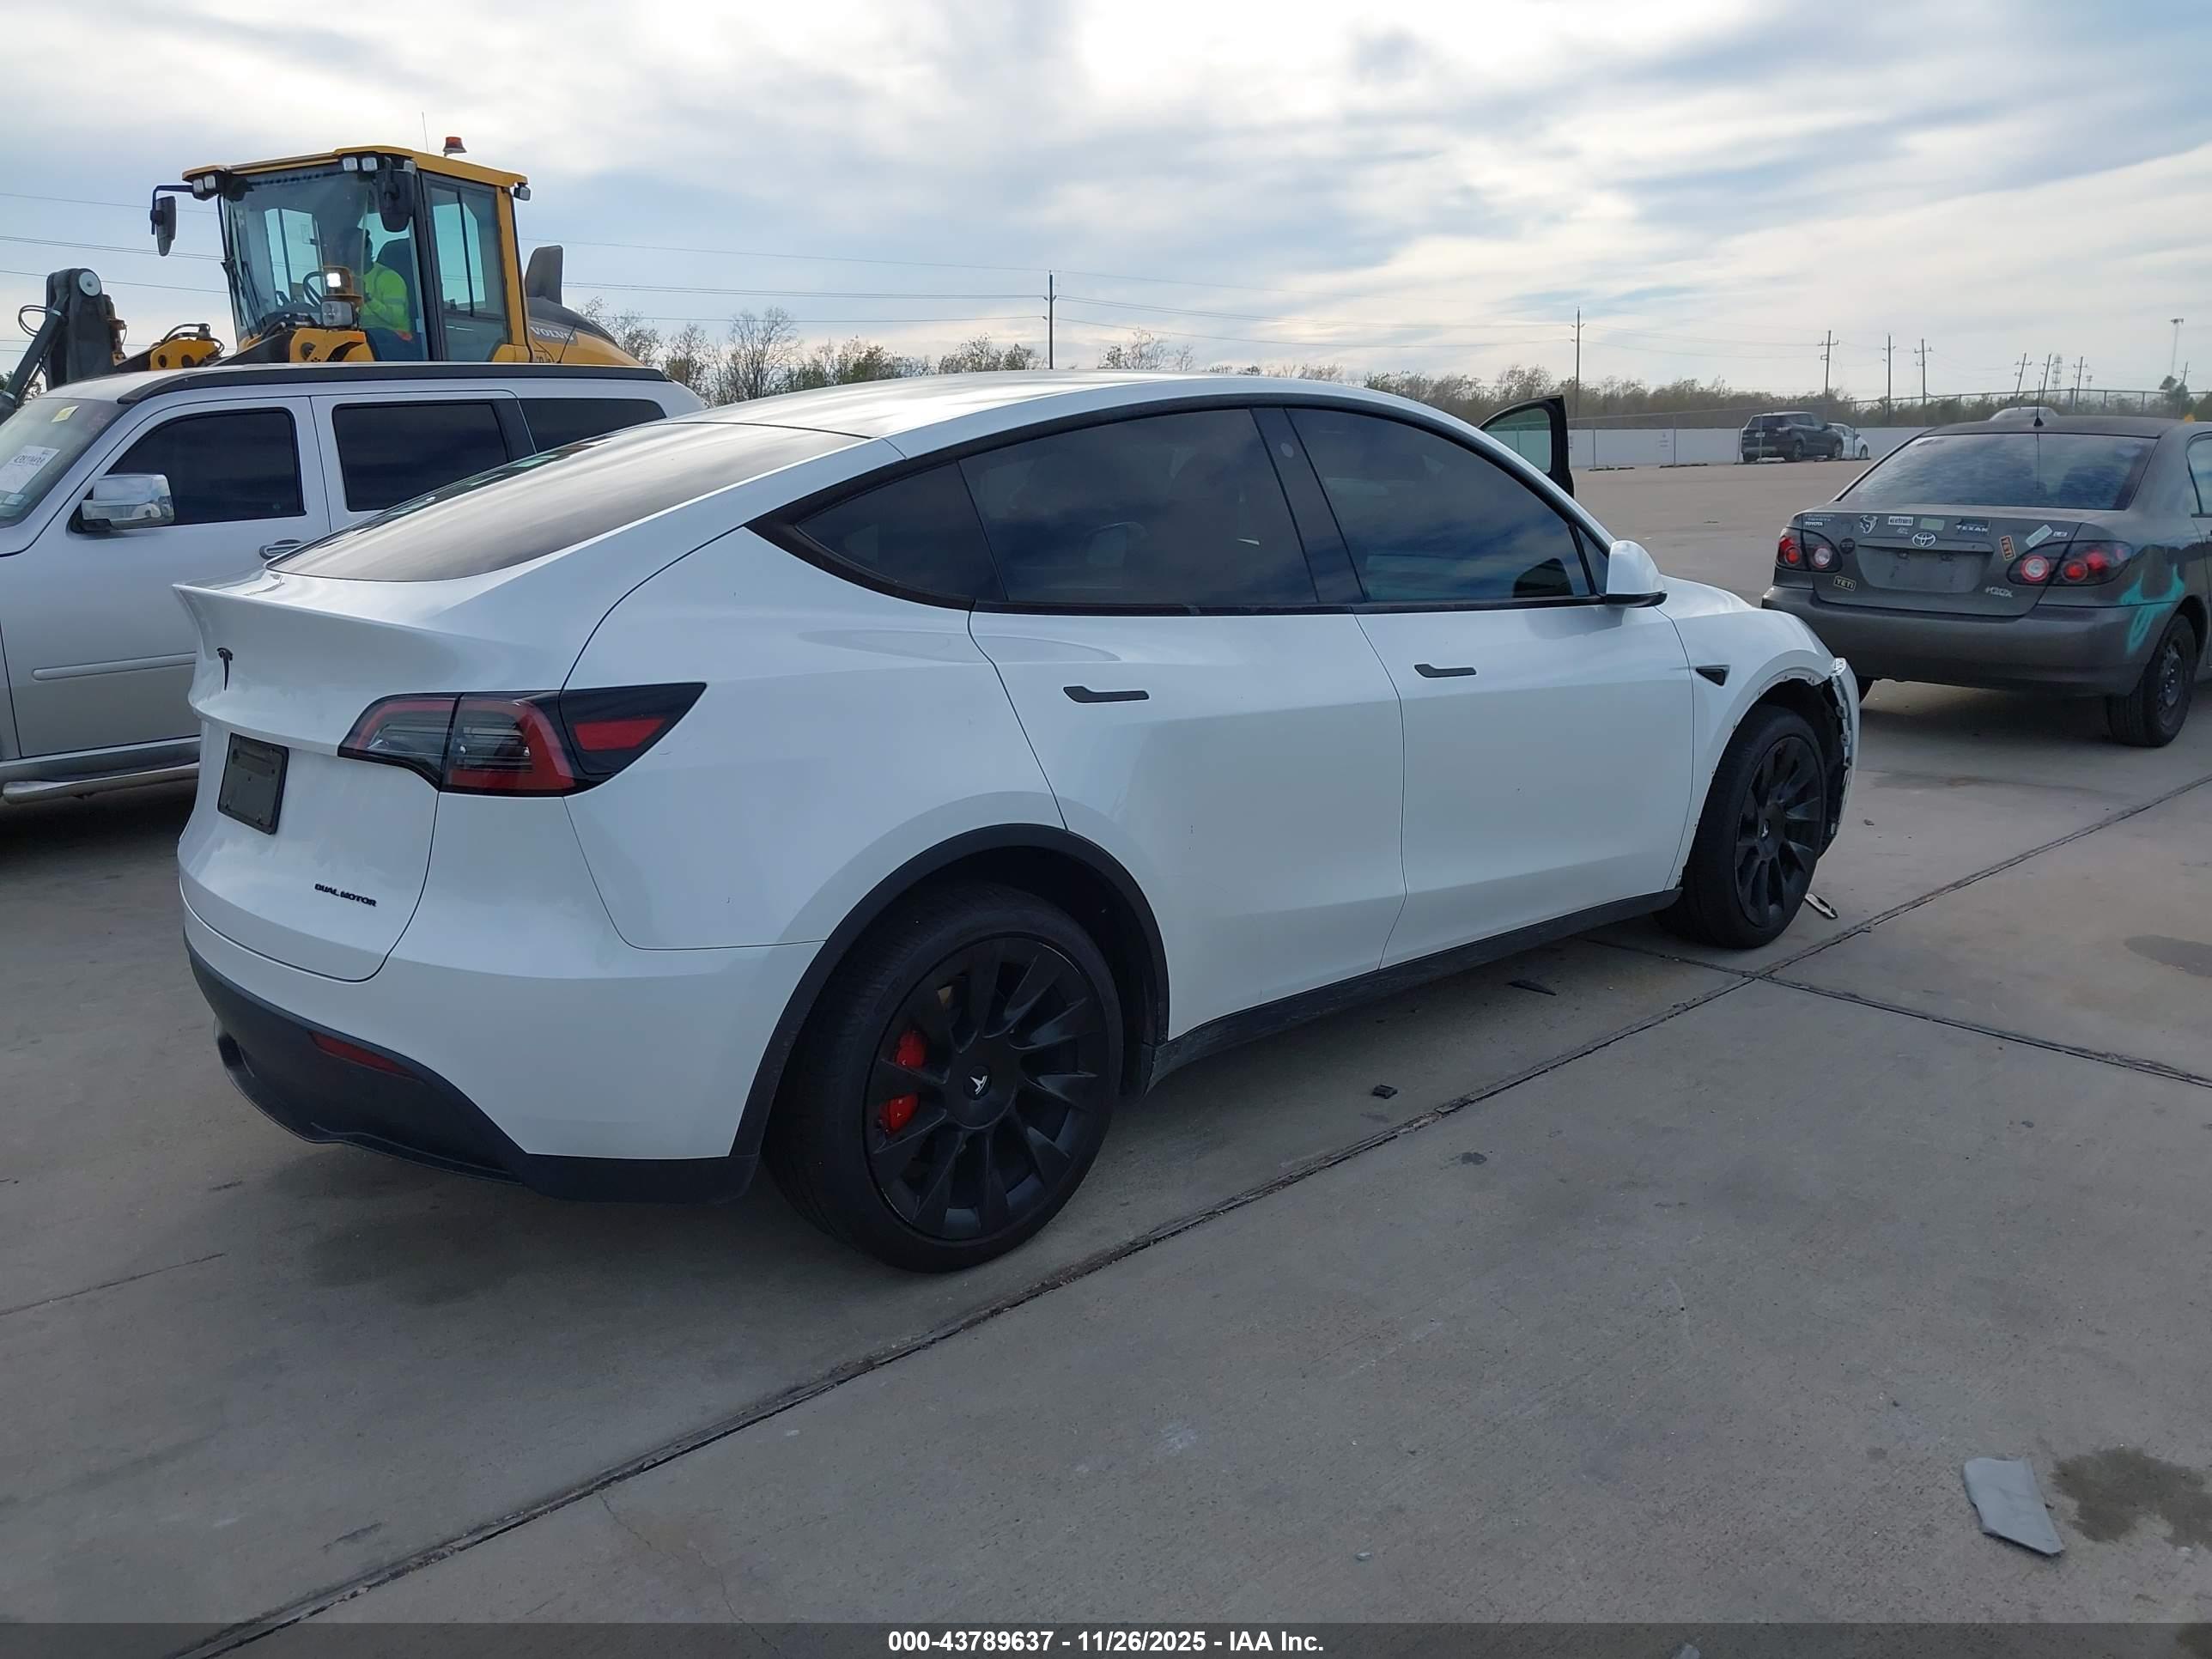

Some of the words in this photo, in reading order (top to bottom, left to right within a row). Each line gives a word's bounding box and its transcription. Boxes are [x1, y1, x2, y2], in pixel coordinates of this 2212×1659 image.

[1836, 578, 1855, 589] YETI
[314, 883, 339, 896] DUAL
[340, 890, 377, 907] MOTOR
